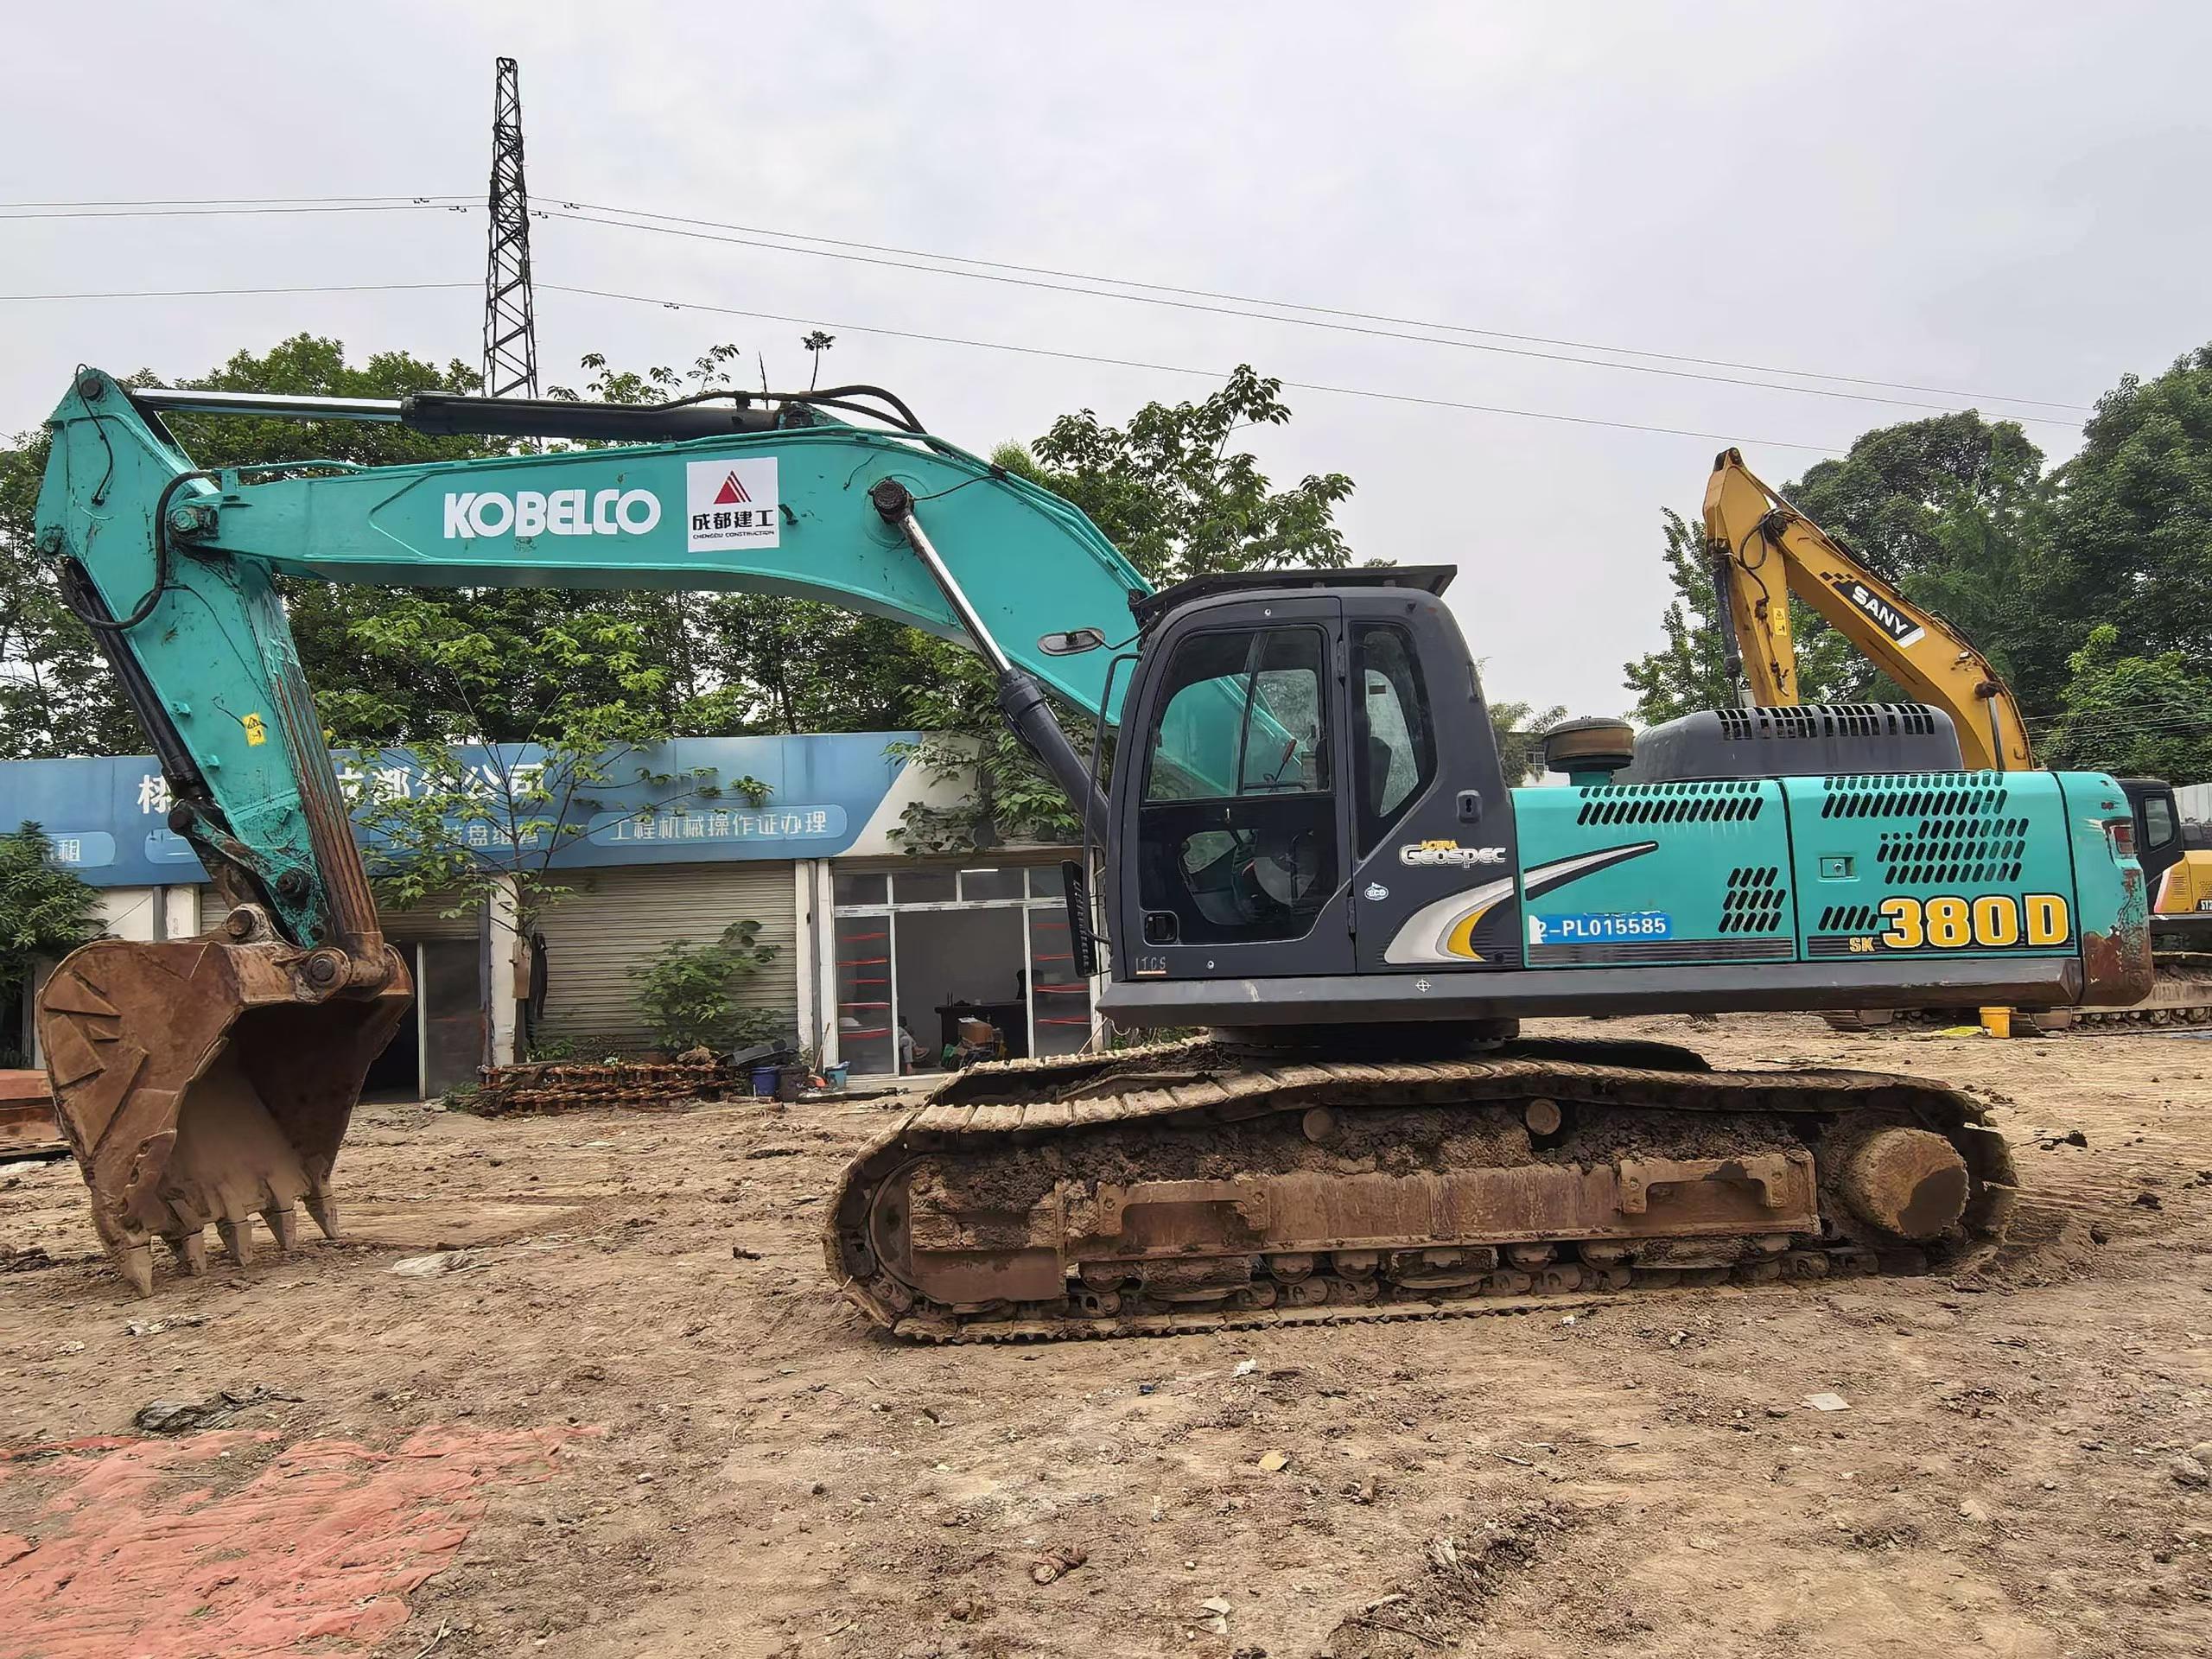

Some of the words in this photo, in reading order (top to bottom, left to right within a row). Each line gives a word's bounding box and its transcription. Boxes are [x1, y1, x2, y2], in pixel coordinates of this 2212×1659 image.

[444, 489, 661, 538] KOBELCO
[692, 510, 774, 531] 成都建工
[1852, 585, 1909, 635] SANY
[609, 810, 827, 841] 工程机械操作证办理
[1848, 936, 1875, 953] SK
[1880, 895, 2069, 949] 380D
